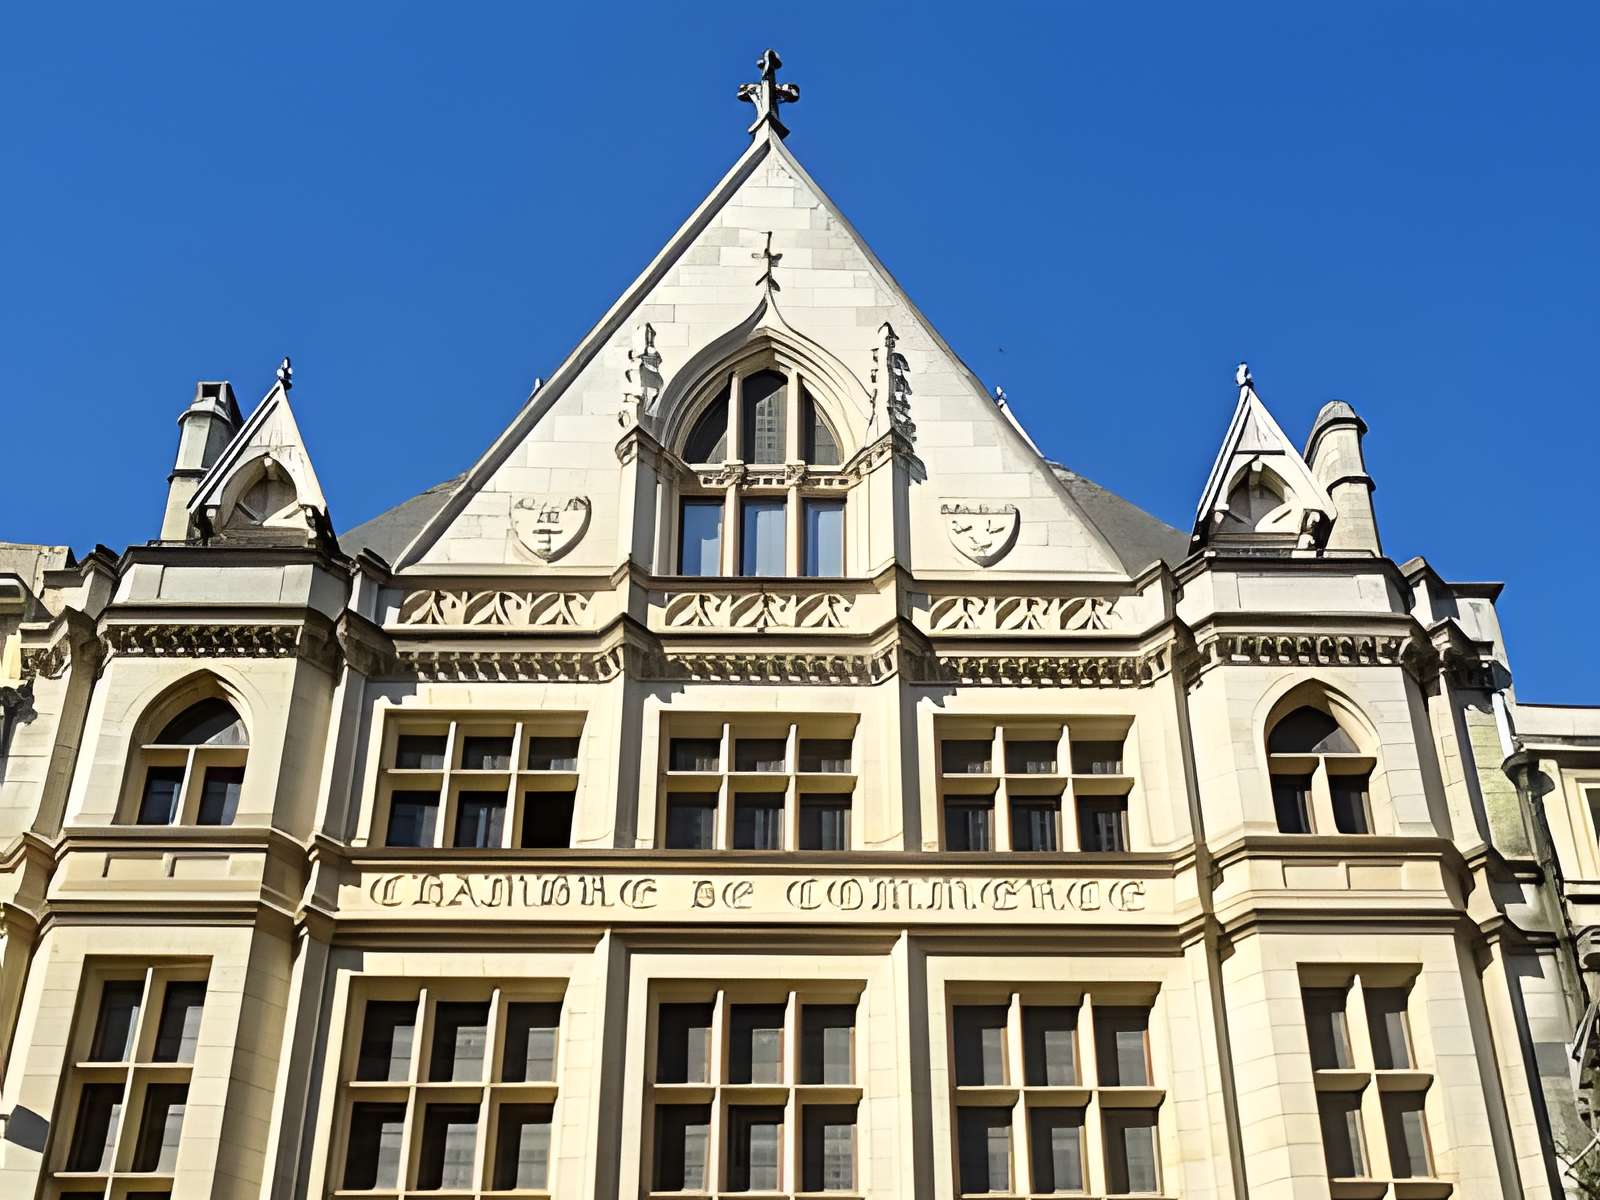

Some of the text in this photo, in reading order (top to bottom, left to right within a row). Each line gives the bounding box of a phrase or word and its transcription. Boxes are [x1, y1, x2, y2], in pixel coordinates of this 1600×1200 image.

[369, 874, 1147, 912] CHAMBRE DE COMMERCE
